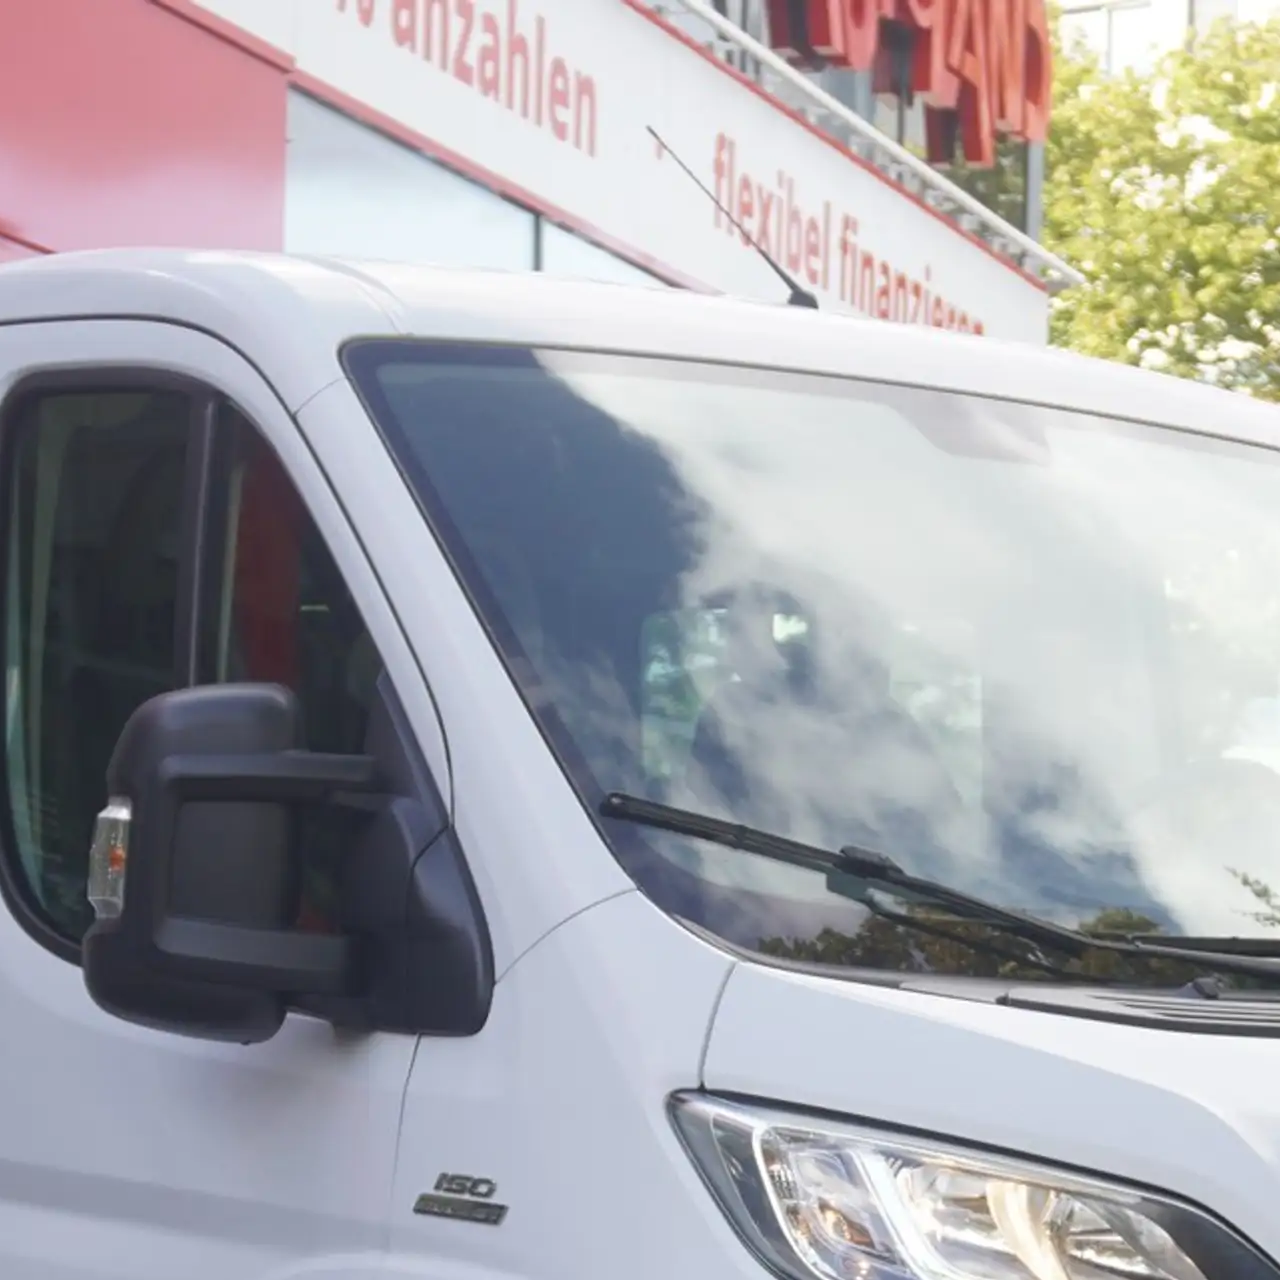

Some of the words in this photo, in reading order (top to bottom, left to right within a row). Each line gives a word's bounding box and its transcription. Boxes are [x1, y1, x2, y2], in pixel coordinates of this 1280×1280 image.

[391, 0, 597, 158] anzahlen
[714, 132, 831, 291] flexibel
[433, 1171, 498, 1199] 150
